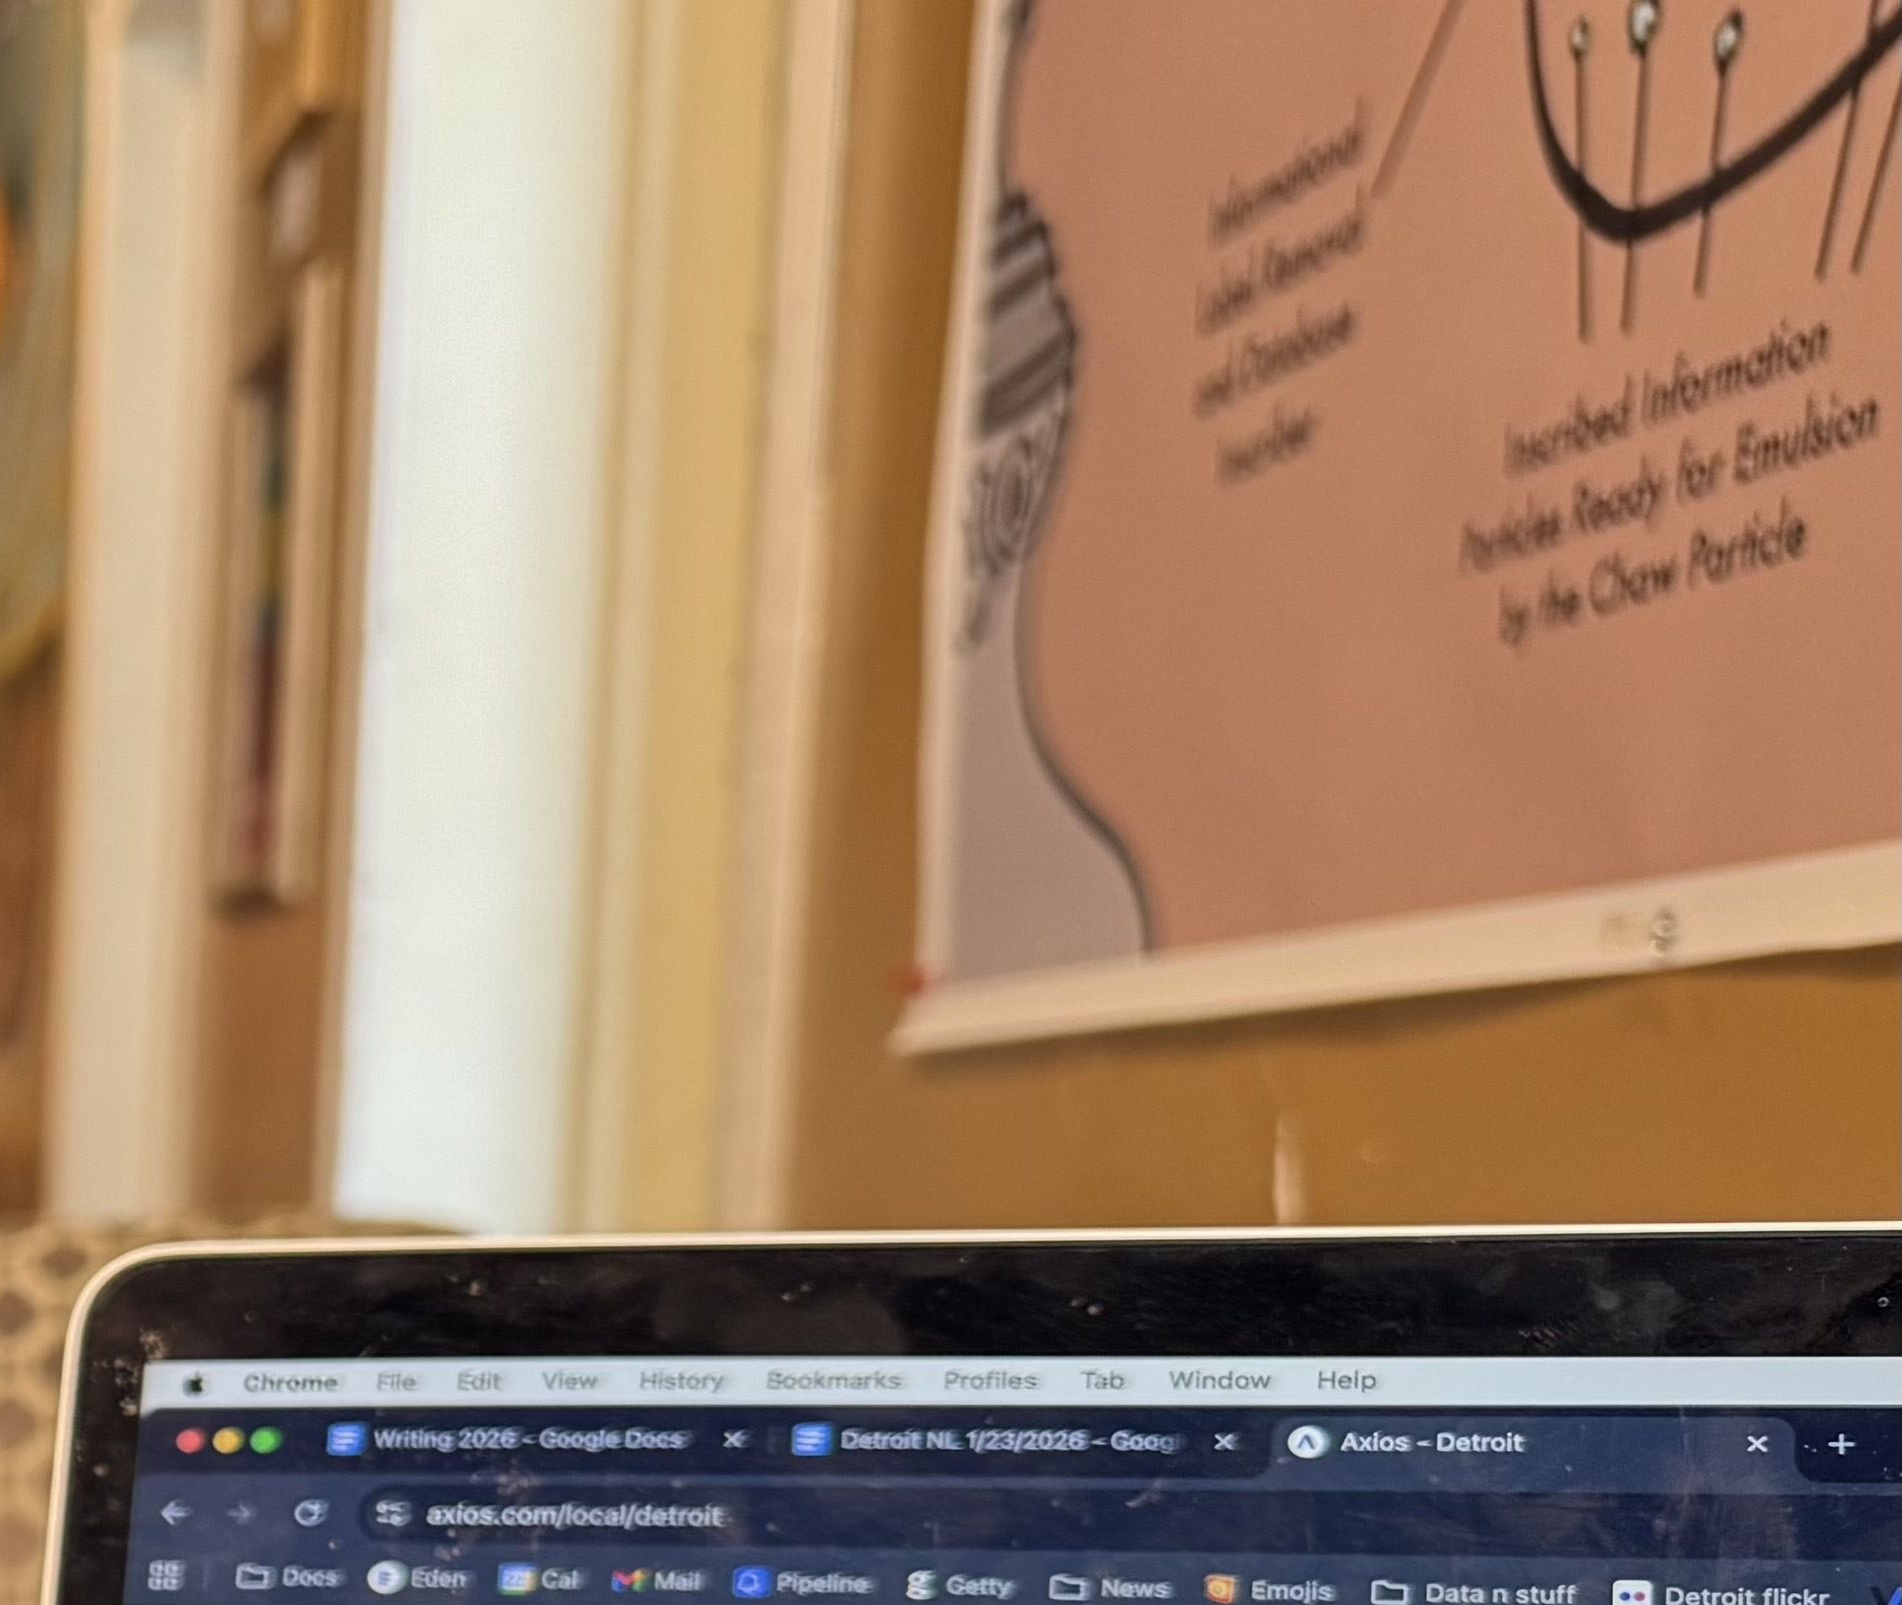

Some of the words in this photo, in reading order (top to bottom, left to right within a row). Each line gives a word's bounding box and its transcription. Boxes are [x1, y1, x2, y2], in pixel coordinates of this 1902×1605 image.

[1504, 372, 1635, 478] Inscribed
[1641, 317, 1829, 424] Information
[1574, 452, 1664, 533] Ready
[1677, 434, 1724, 500] for
[1734, 389, 1879, 485] Emulsion
[1689, 495, 1807, 589] Particle
[244, 1372, 338, 1392] Chrome
[377, 1372, 416, 1391] File
[458, 1372, 502, 1391] Edit
[542, 1371, 599, 1390] View
[640, 1371, 724, 1393] History
[767, 1370, 902, 1390] Bookmarks
[944, 1370, 1039, 1390] Profiles
[1081, 1370, 1124, 1390] Tab
[1169, 1370, 1271, 1390] Window
[1318, 1370, 1377, 1393] Help
[375, 1427, 453, 1452] Writing
[457, 1428, 518, 1449] 2026
[539, 1427, 621, 1452] Google
[624, 1427, 687, 1449] Docs
[841, 1428, 924, 1450] Detroit
[926, 1431, 961, 1450] NL
[966, 1429, 1088, 1454] 1/23/2026
[1340, 1431, 1410, 1452] Axios
[1436, 1432, 1525, 1452] Detroit
[426, 1503, 729, 1530] axios.com/local/detroit
[283, 1565, 341, 1588] Docs
[411, 1567, 468, 1589] Eden
[541, 1569, 581, 1591] Cal
[655, 1571, 703, 1591] Mail
[776, 1572, 875, 1597] Pipeline
[947, 1575, 1016, 1600] Getty
[1101, 1579, 1174, 1600] News
[1251, 1580, 1336, 1605] Emojis
[1425, 1583, 1484, 1604] Data
[1492, 1589, 1508, 1603] n
[1515, 1584, 1577, 1605] stuff
